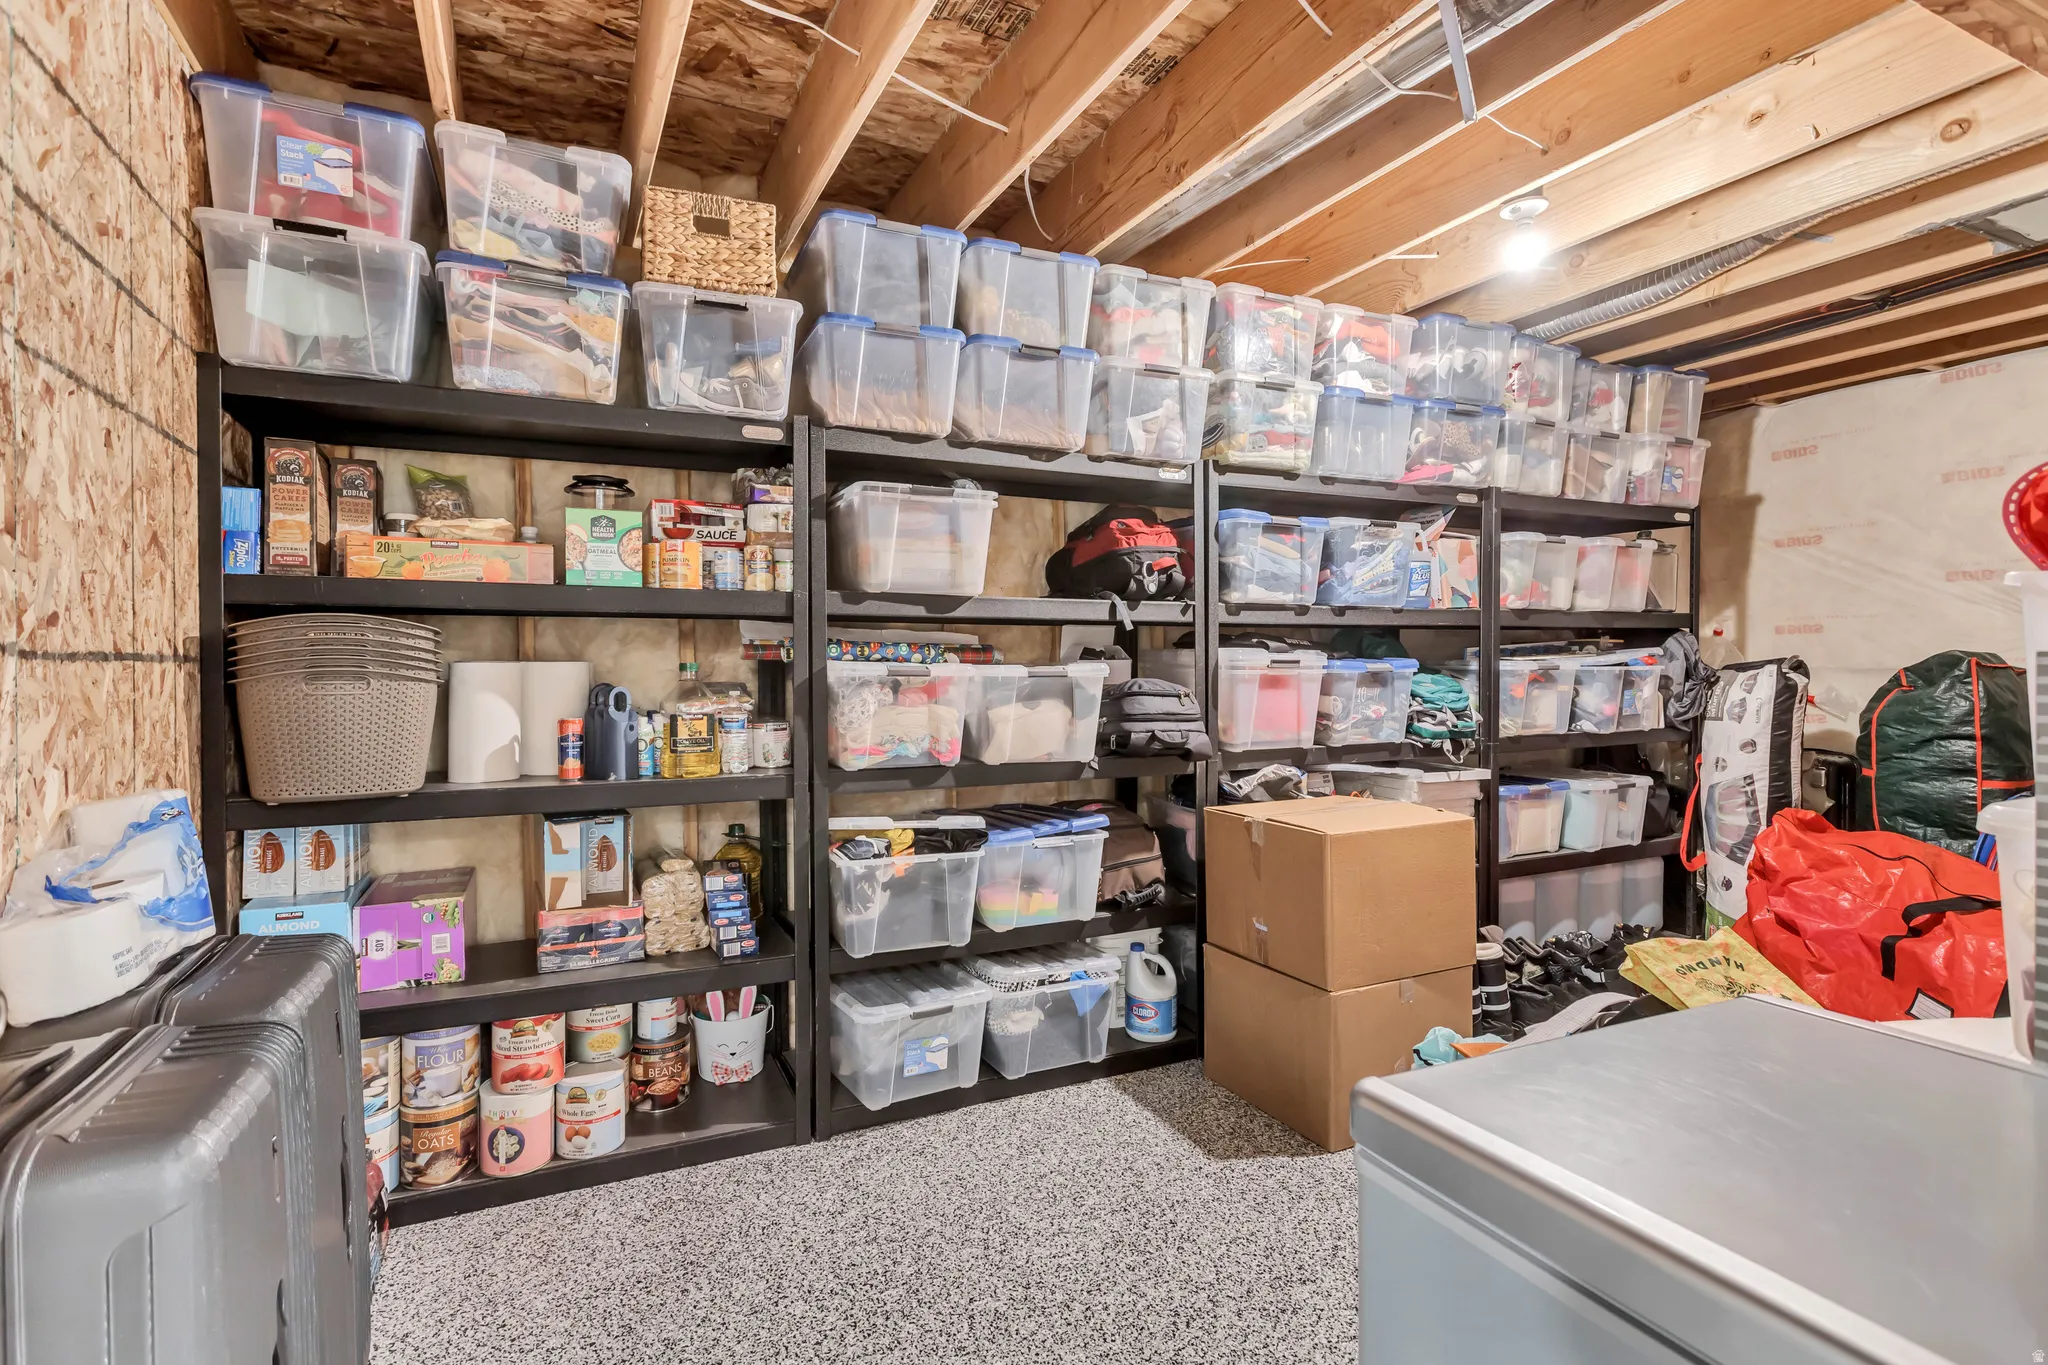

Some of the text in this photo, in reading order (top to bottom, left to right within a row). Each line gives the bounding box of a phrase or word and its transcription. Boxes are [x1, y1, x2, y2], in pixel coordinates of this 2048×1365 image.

[280, 139, 303, 150] Clear
[280, 149, 305, 160] Stack
[276, 475, 306, 485] KODIAK
[271, 487, 309, 496] POWER
[342, 489, 369, 499] KODIAK
[273, 494, 307, 502] CAKES
[339, 500, 372, 509] POWER
[340, 507, 371, 515] CAKES
[696, 530, 738, 541] SAUCE
[376, 541, 390, 554] 20
[234, 541, 249, 569] Ziploc
[420, 548, 489, 572] Peaches
[1711, 695, 1719, 718] INSTANT
[588, 828, 599, 887] ALMOND
[259, 920, 319, 934] ALMOND
[375, 939, 384, 953] SOY
[570, 957, 620, 968] SANPELLEGRINO
[424, 972, 433, 980] 12
[1133, 1006, 1155, 1018] CLOROX
[512, 1040, 555, 1052] Strawberries
[417, 1049, 464, 1068] FLOUR
[648, 1063, 682, 1078] BEANS
[489, 1109, 524, 1117] THRIVE
[420, 1128, 451, 1139] Regular
[418, 1134, 454, 1149] OATS
